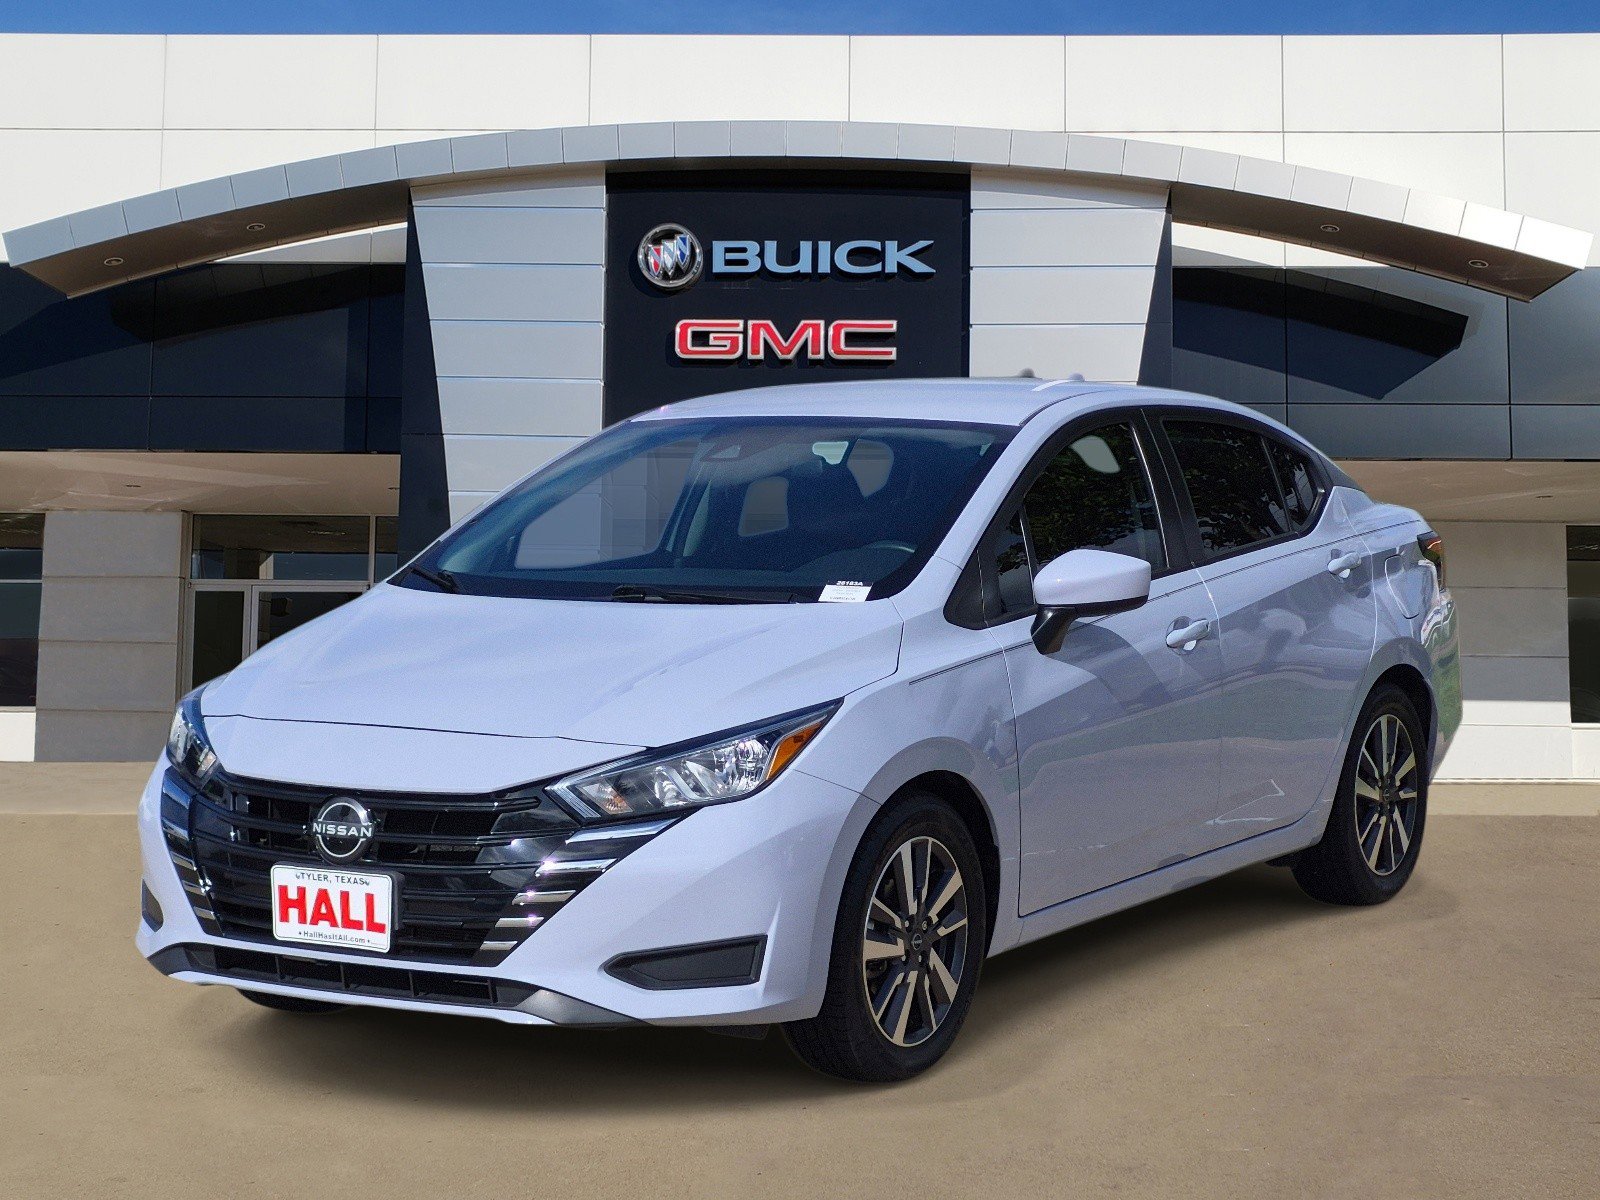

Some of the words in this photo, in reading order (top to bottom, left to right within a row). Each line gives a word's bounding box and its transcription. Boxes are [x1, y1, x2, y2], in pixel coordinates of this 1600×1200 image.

[711, 240, 936, 274] BUICK
[674, 319, 898, 360] GMC
[312, 822, 373, 837] NISSAN
[301, 872, 332, 883] TYLER,
[335, 875, 365, 886] TEXAS
[278, 884, 387, 934] HALL
